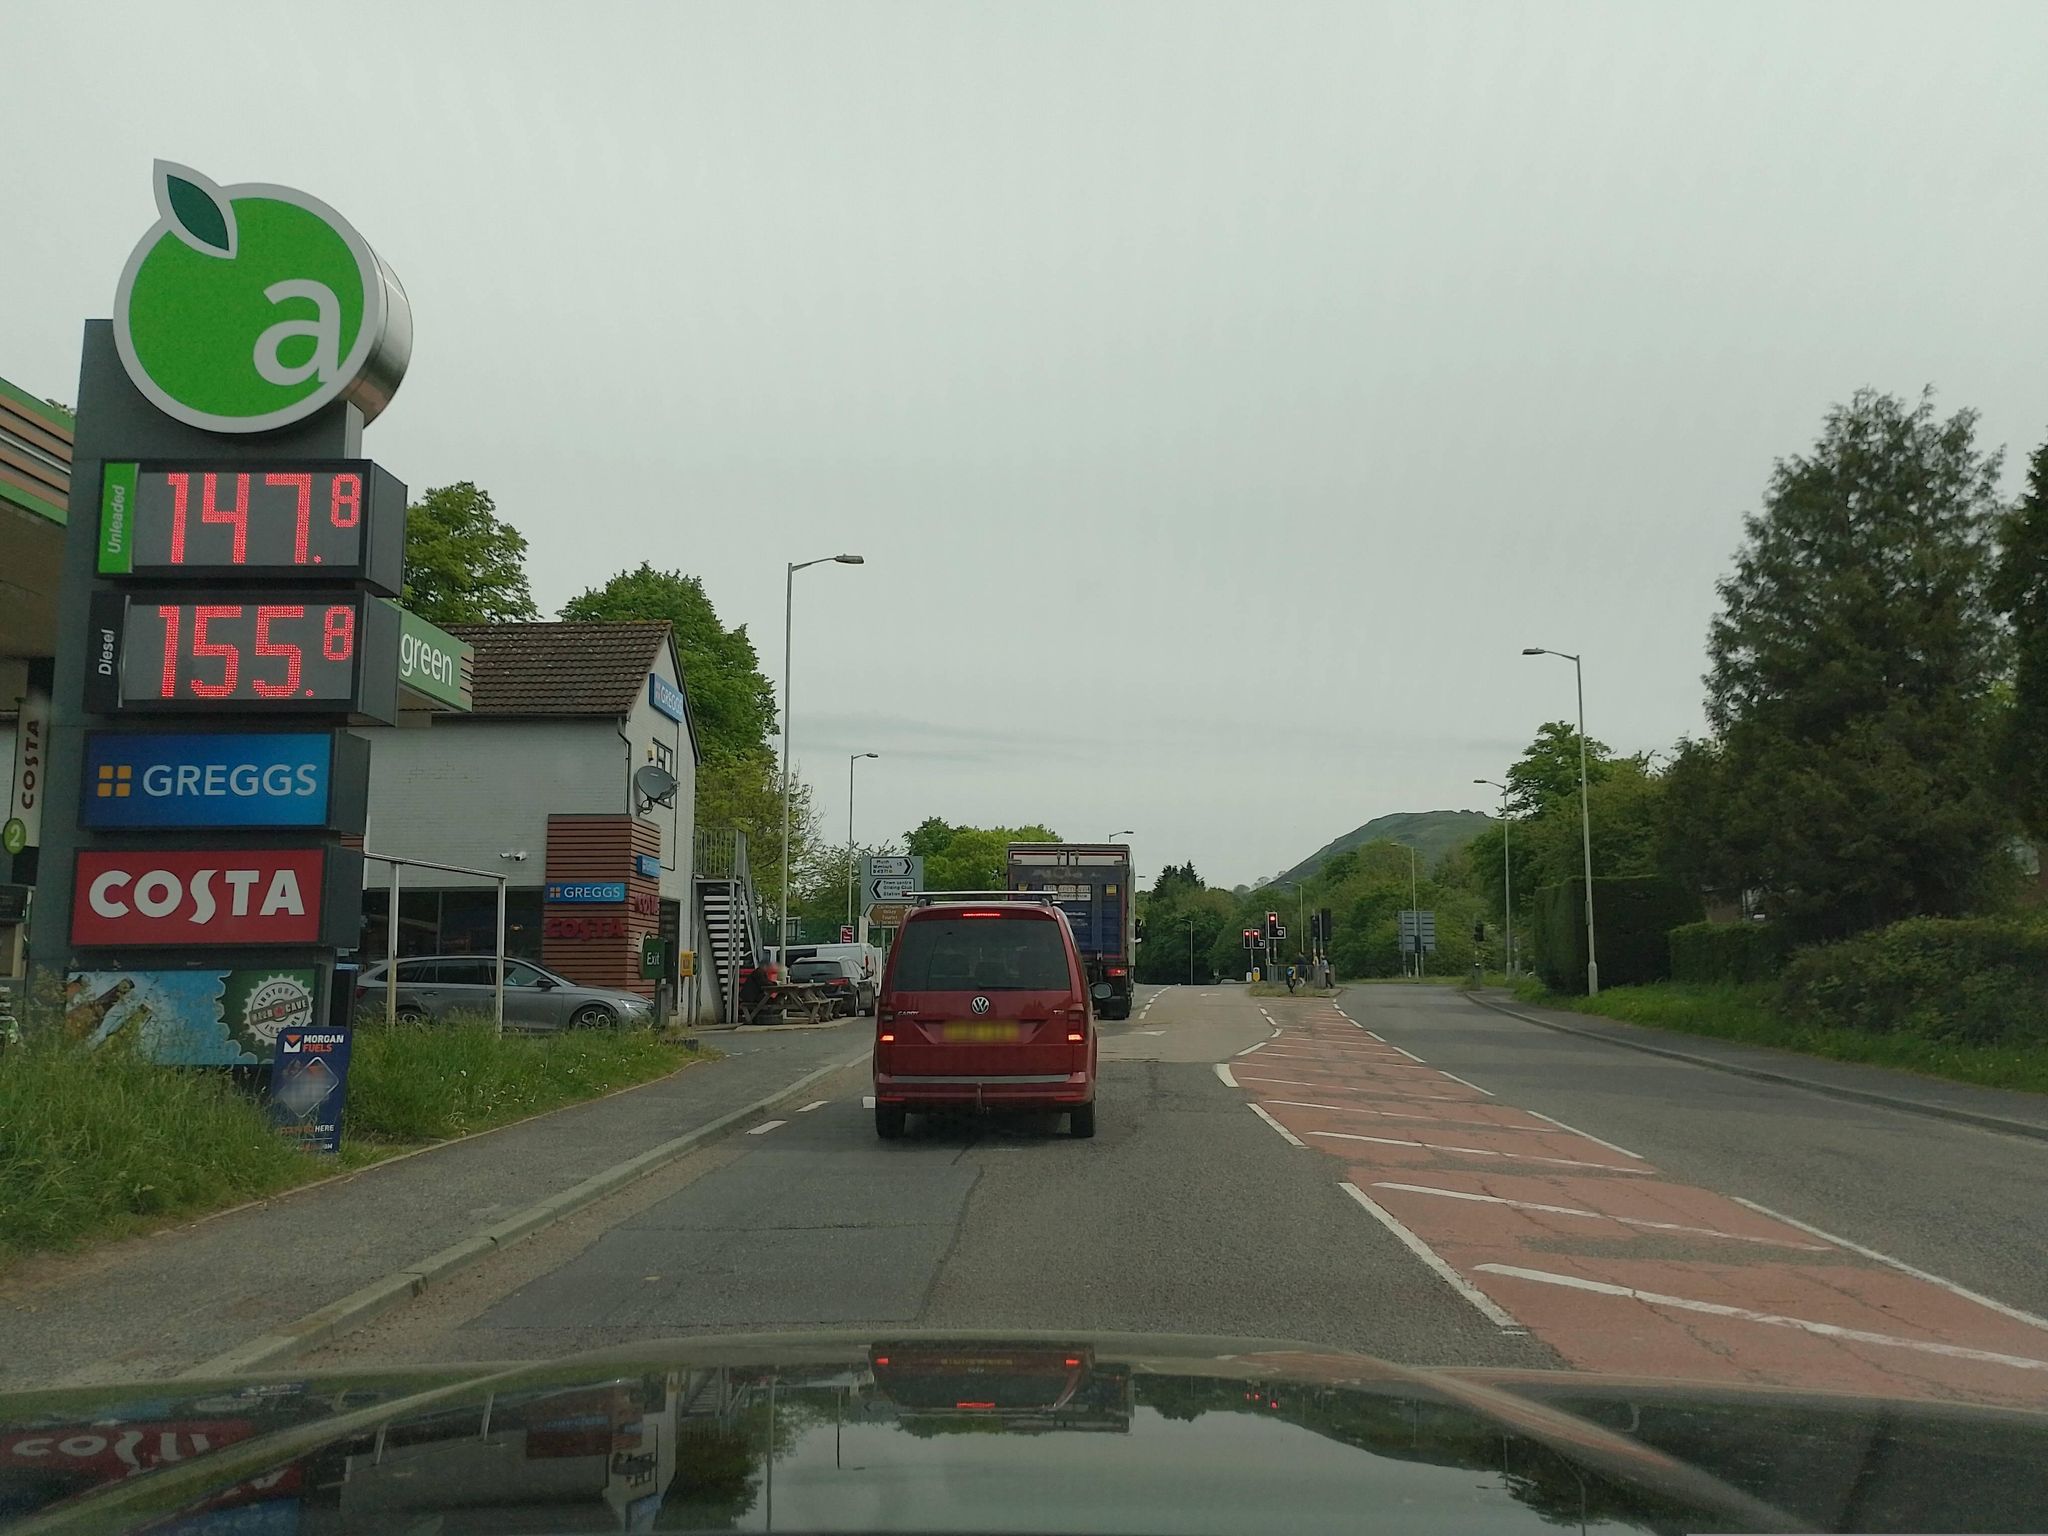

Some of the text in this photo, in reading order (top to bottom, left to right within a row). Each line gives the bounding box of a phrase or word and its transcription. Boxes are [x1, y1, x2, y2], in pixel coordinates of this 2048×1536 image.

[252, 277, 342, 388] a
[107, 484, 127, 554] Unleaded
[97, 627, 115, 677] Diesel
[400, 632, 454, 688] green
[21, 719, 40, 810] COSTA
[143, 763, 318, 798] GREGGS
[9, 824, 22, 848] 2
[88, 868, 306, 925] COSTA
[564, 886, 621, 899] GREGGS
[545, 918, 626, 941] COSTA
[646, 951, 661, 967] Exit
[285, 999, 308, 1013] CAVE
[302, 1043, 333, 1053] FUELS
[303, 1034, 345, 1044] MORGAN
[314, 1124, 335, 1133] HERE
